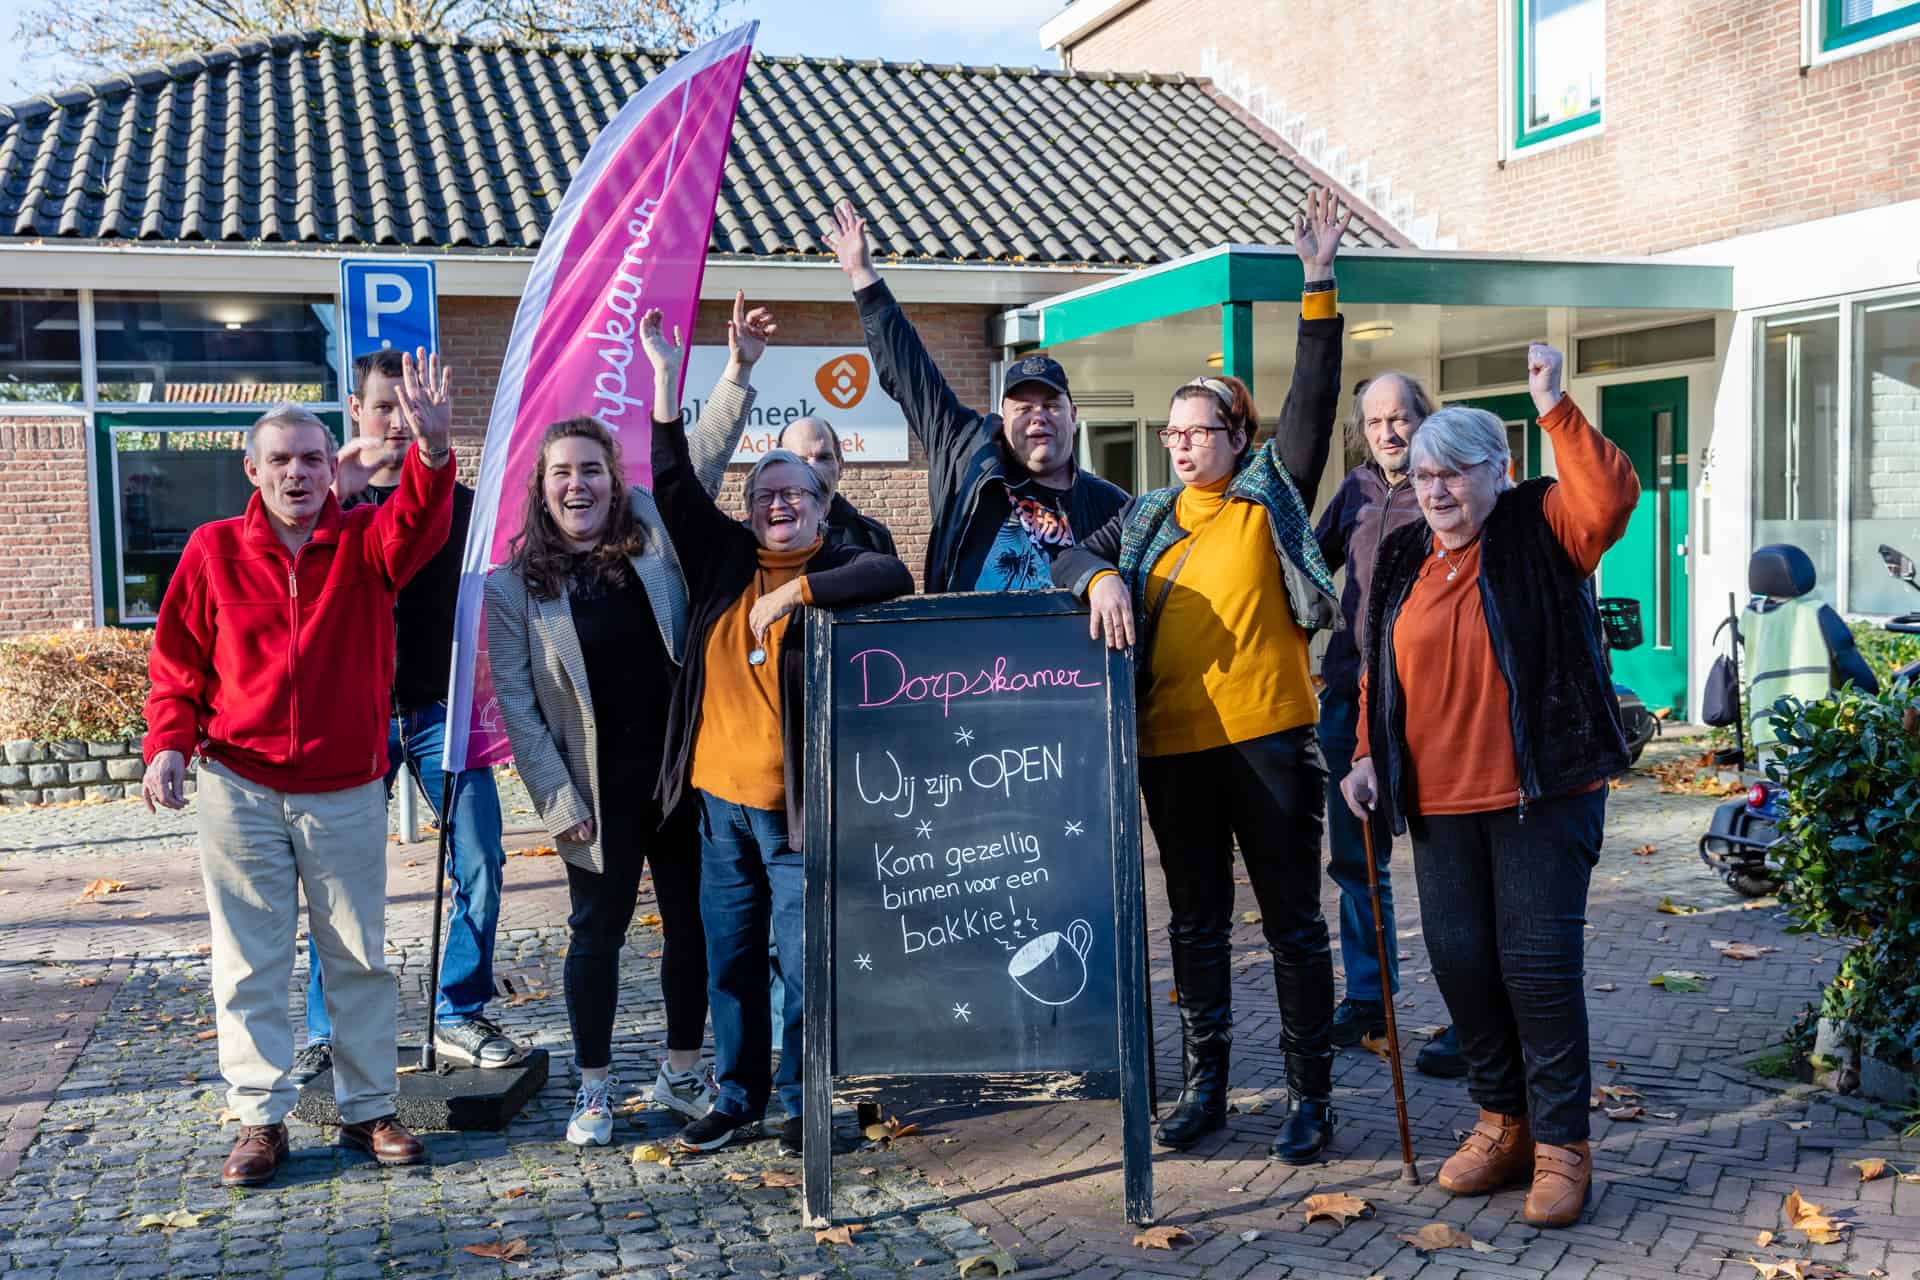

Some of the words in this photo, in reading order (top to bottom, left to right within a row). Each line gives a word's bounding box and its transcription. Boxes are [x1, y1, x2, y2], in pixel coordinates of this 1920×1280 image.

[364, 272, 413, 338] P
[739, 432, 865, 453] Achek
[849, 648, 1103, 718] Dorpskamer
[855, 750, 917, 819] Wij
[923, 773, 963, 808] zijn
[968, 742, 1064, 799] OPEN
[874, 842, 935, 881] Kom
[945, 831, 1041, 877] gezellig
[882, 882, 961, 911] binnen
[963, 875, 1002, 896] voor
[1006, 867, 1050, 890] een
[900, 896, 1023, 955] bakkie!
